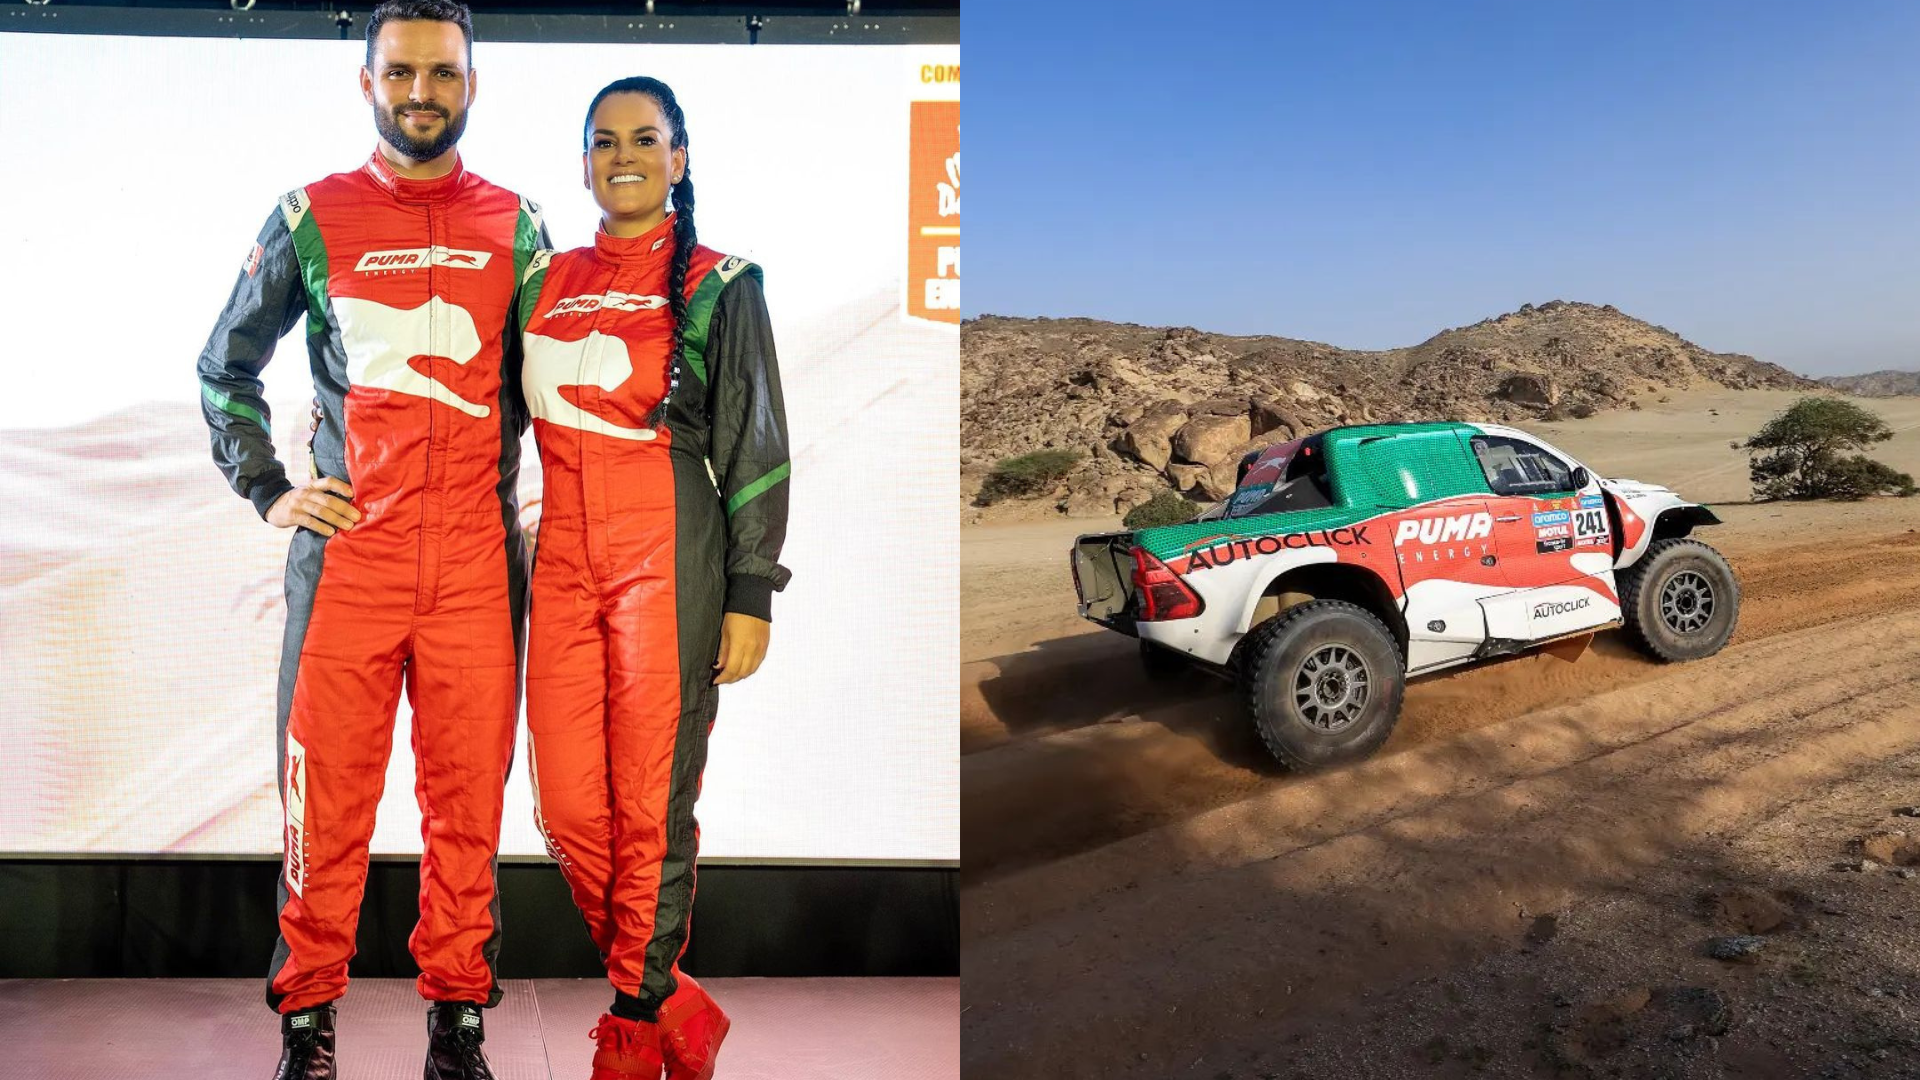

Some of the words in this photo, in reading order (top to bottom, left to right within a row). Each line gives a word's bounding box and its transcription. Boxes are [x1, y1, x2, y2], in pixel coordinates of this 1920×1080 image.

[364, 253, 419, 267] PUMA
[365, 269, 415, 277] ENERGY
[554, 298, 600, 313] PUMA
[1534, 512, 1567, 524] aramco
[1575, 511, 1606, 536] 241
[1394, 512, 1493, 548] PUMA
[1538, 525, 1568, 539] MOTUL
[1186, 526, 1372, 574] AUTOCLICK
[1397, 544, 1487, 564] ENERGY
[1533, 596, 1591, 620] AUTOCLICK
[289, 824, 300, 886] PUMA
[291, 1016, 310, 1027] OMP
[462, 1016, 480, 1026] OMP
